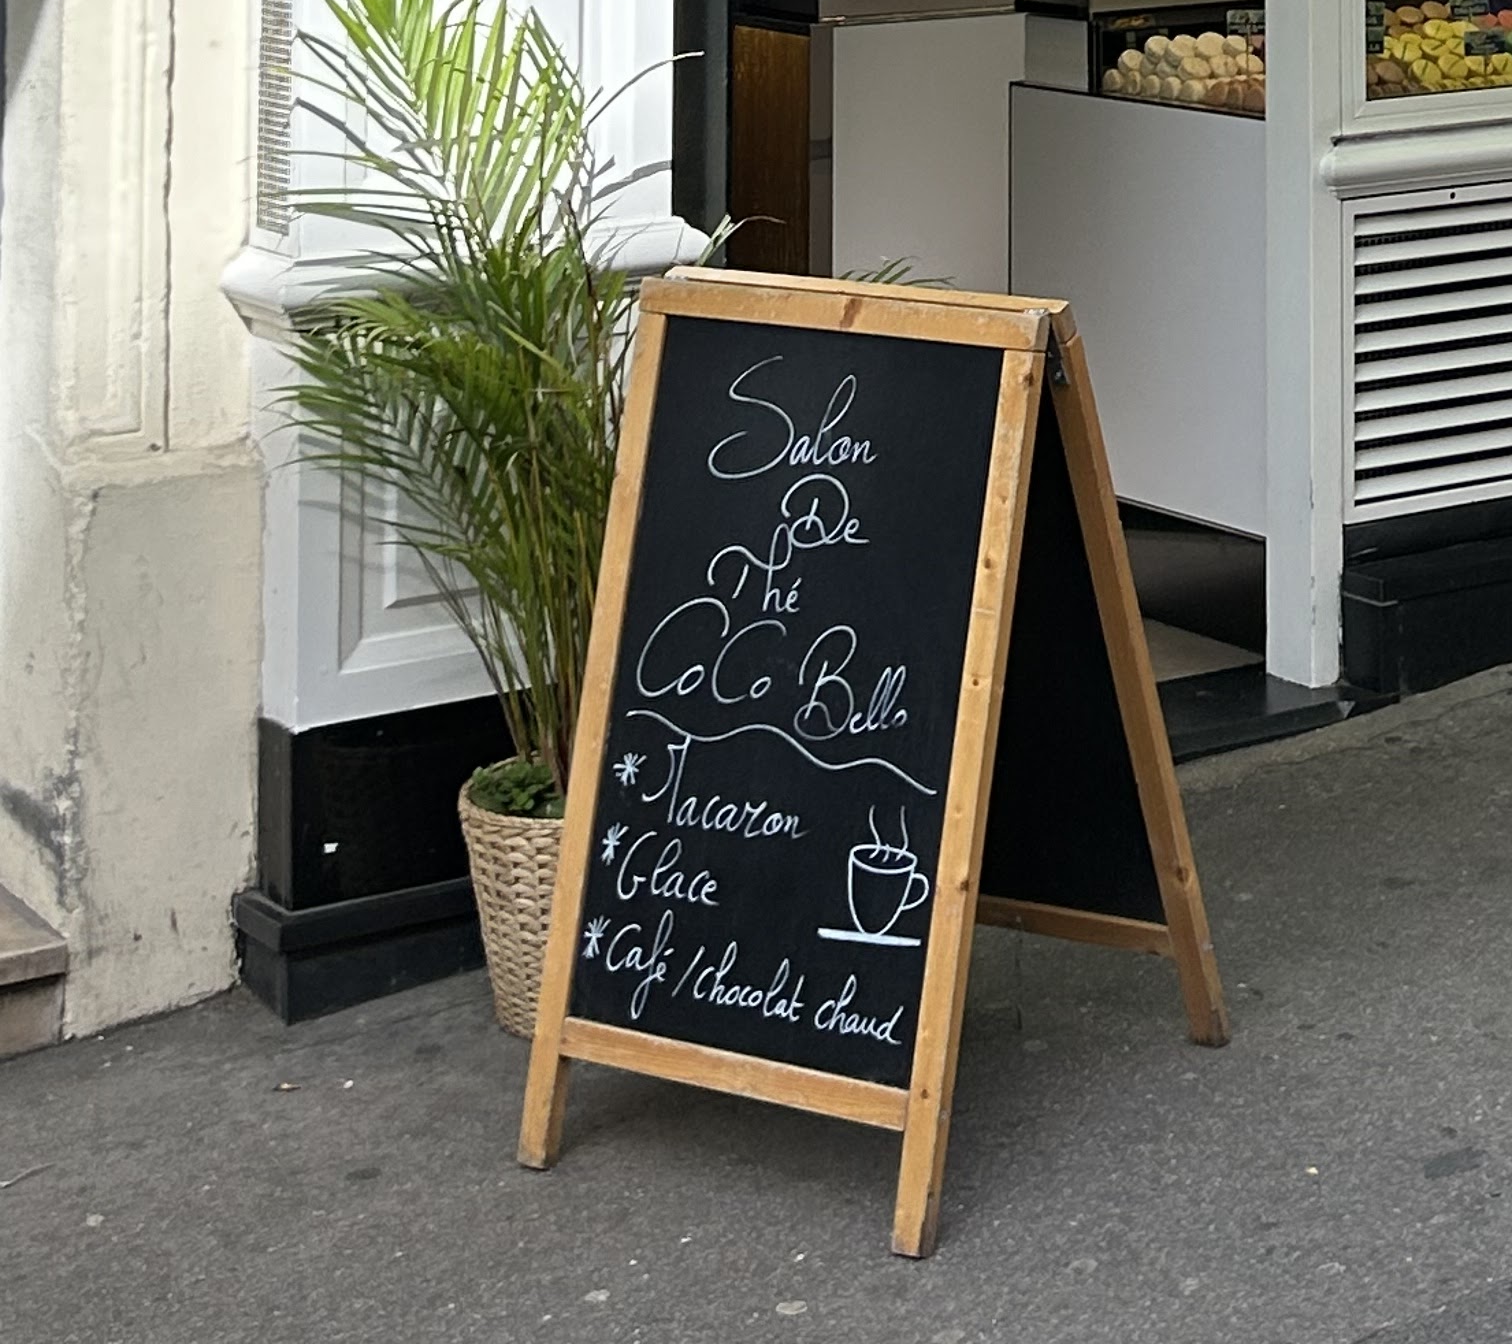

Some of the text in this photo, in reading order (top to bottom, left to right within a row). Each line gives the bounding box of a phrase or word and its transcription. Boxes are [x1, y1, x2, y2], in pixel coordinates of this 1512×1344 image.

[707, 355, 878, 480] Salon
[781, 473, 870, 548] De
[707, 523, 804, 612] Thé
[617, 831, 720, 906] Glace
[605, 909, 675, 1021] Café
[813, 974, 905, 1045] chaud
